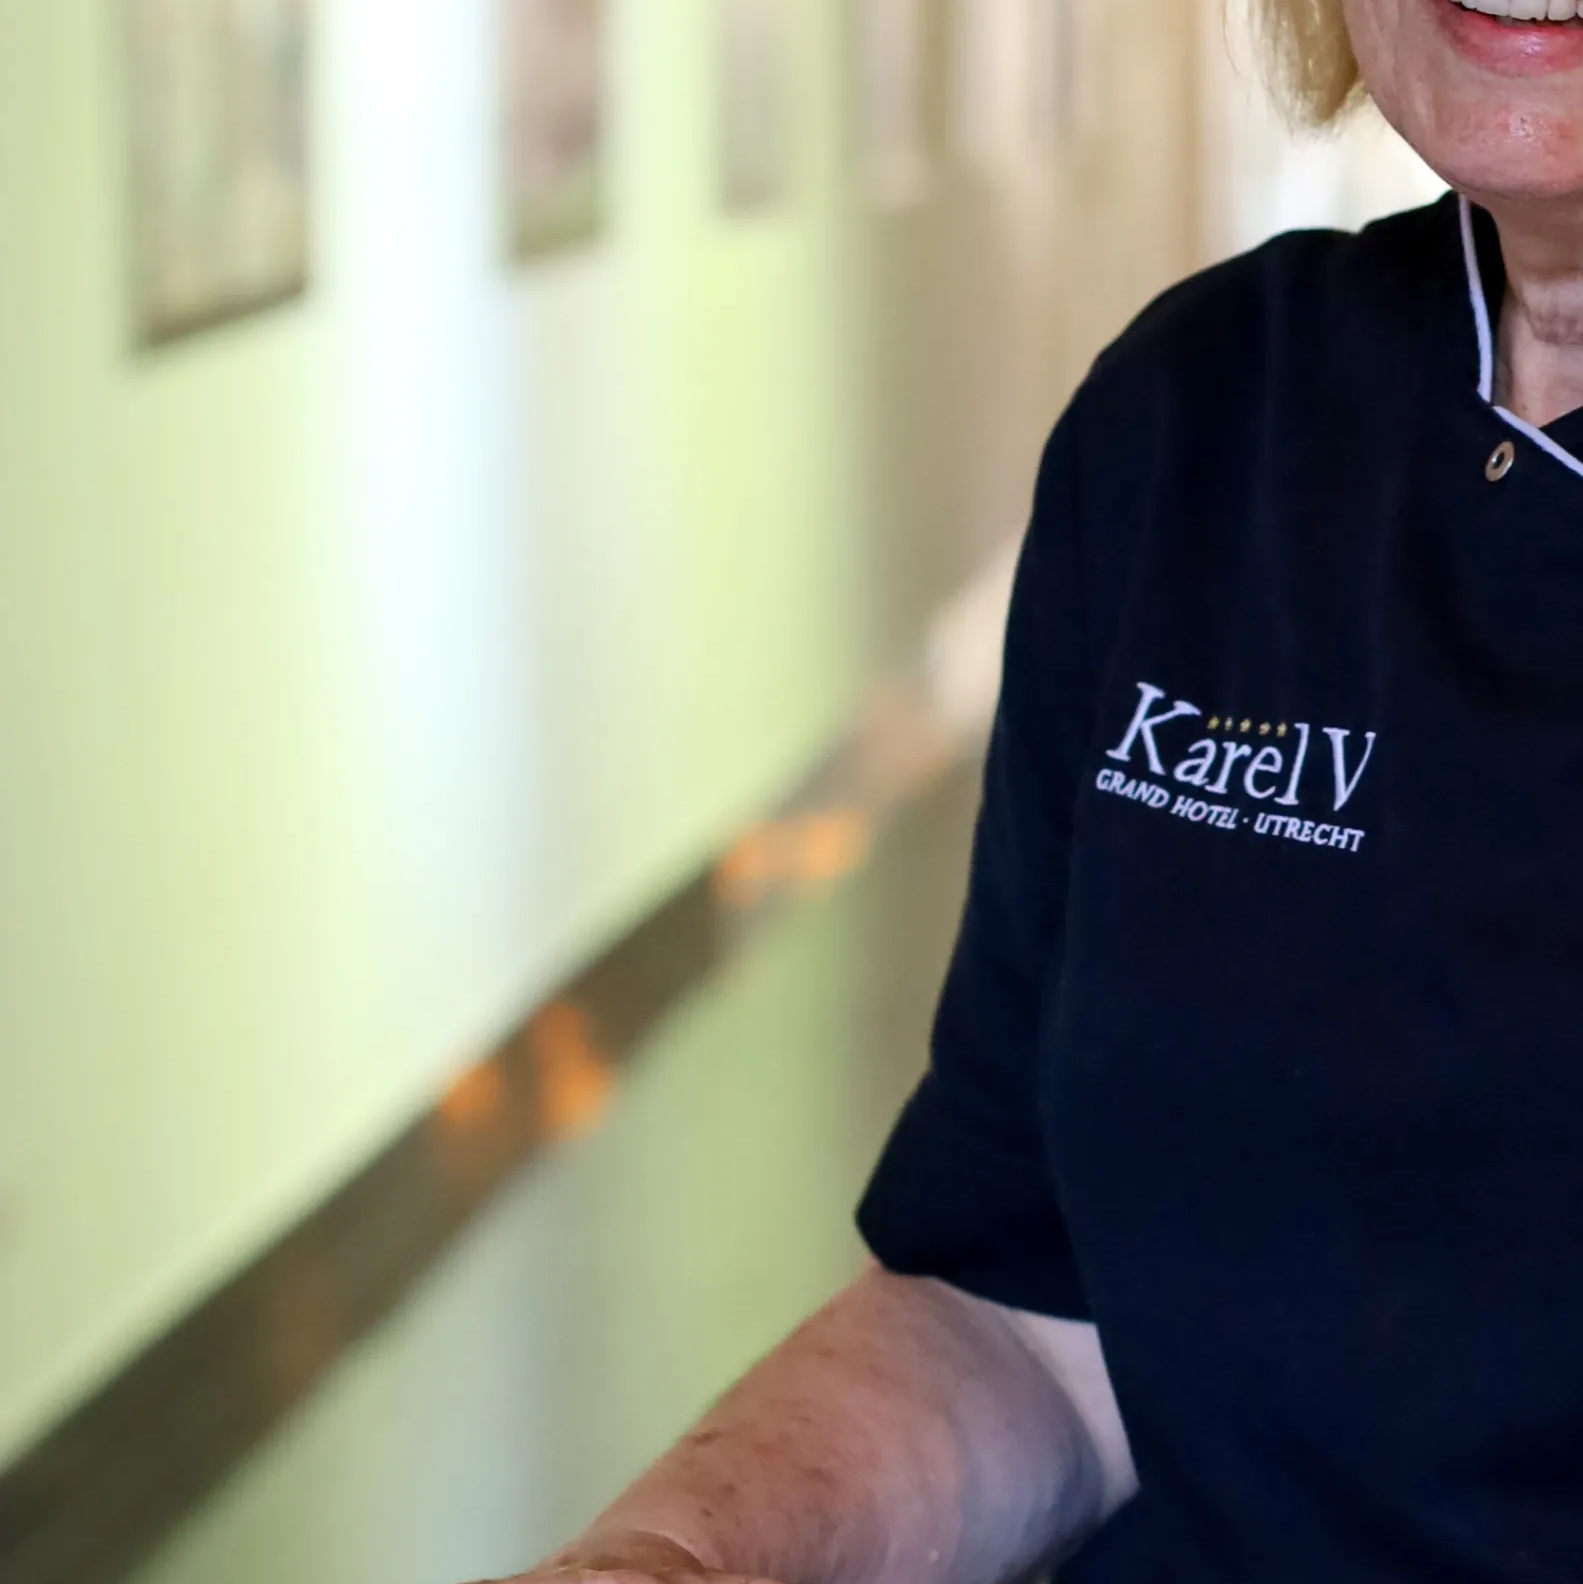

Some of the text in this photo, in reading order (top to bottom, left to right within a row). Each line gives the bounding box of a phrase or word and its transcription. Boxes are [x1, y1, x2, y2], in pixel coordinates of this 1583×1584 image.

[1105, 681, 1377, 812] Karel V
[1095, 768, 1366, 853] GRAND HOTEL UTRECHT
